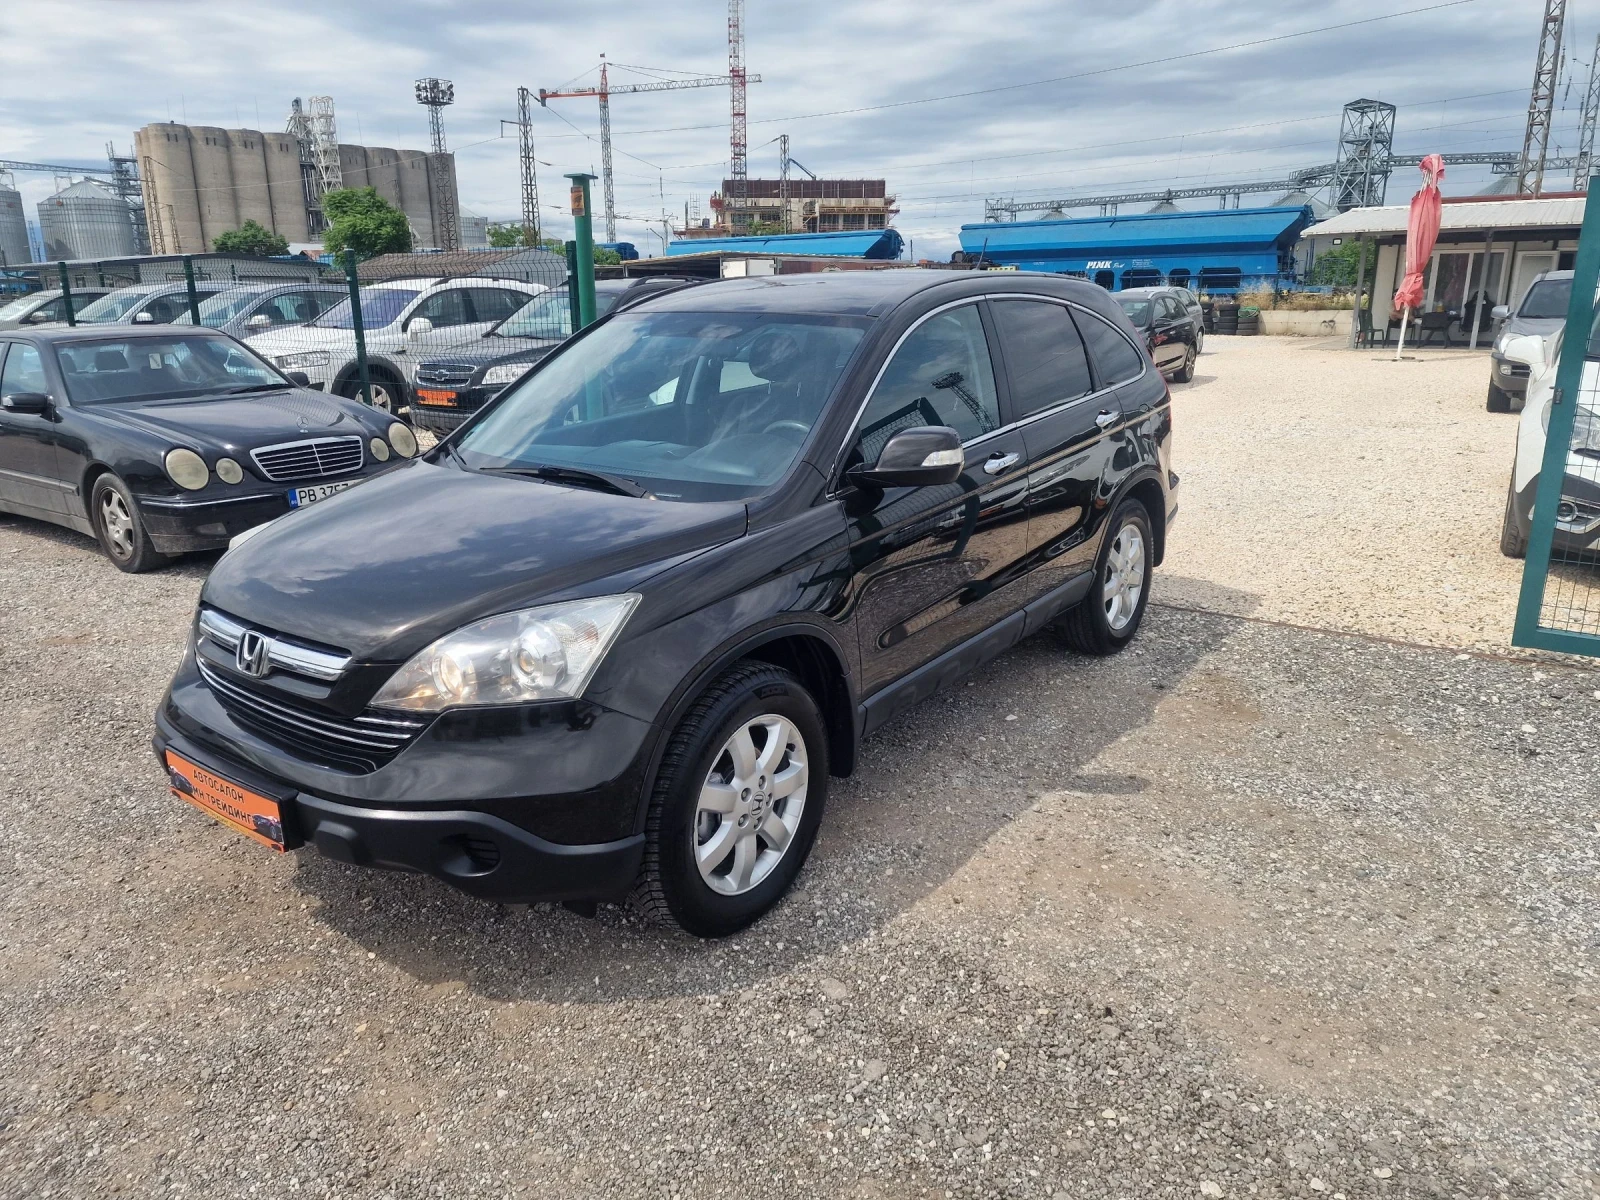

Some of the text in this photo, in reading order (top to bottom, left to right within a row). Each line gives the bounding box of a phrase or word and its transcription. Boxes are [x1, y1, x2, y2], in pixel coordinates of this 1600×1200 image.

[1086, 261, 1112, 269] PIMK
[298, 489, 317, 503] PB
[193, 769, 245, 804] АВТОСАЛОН
[206, 793, 251, 824] ТРЕЙДИНГ
